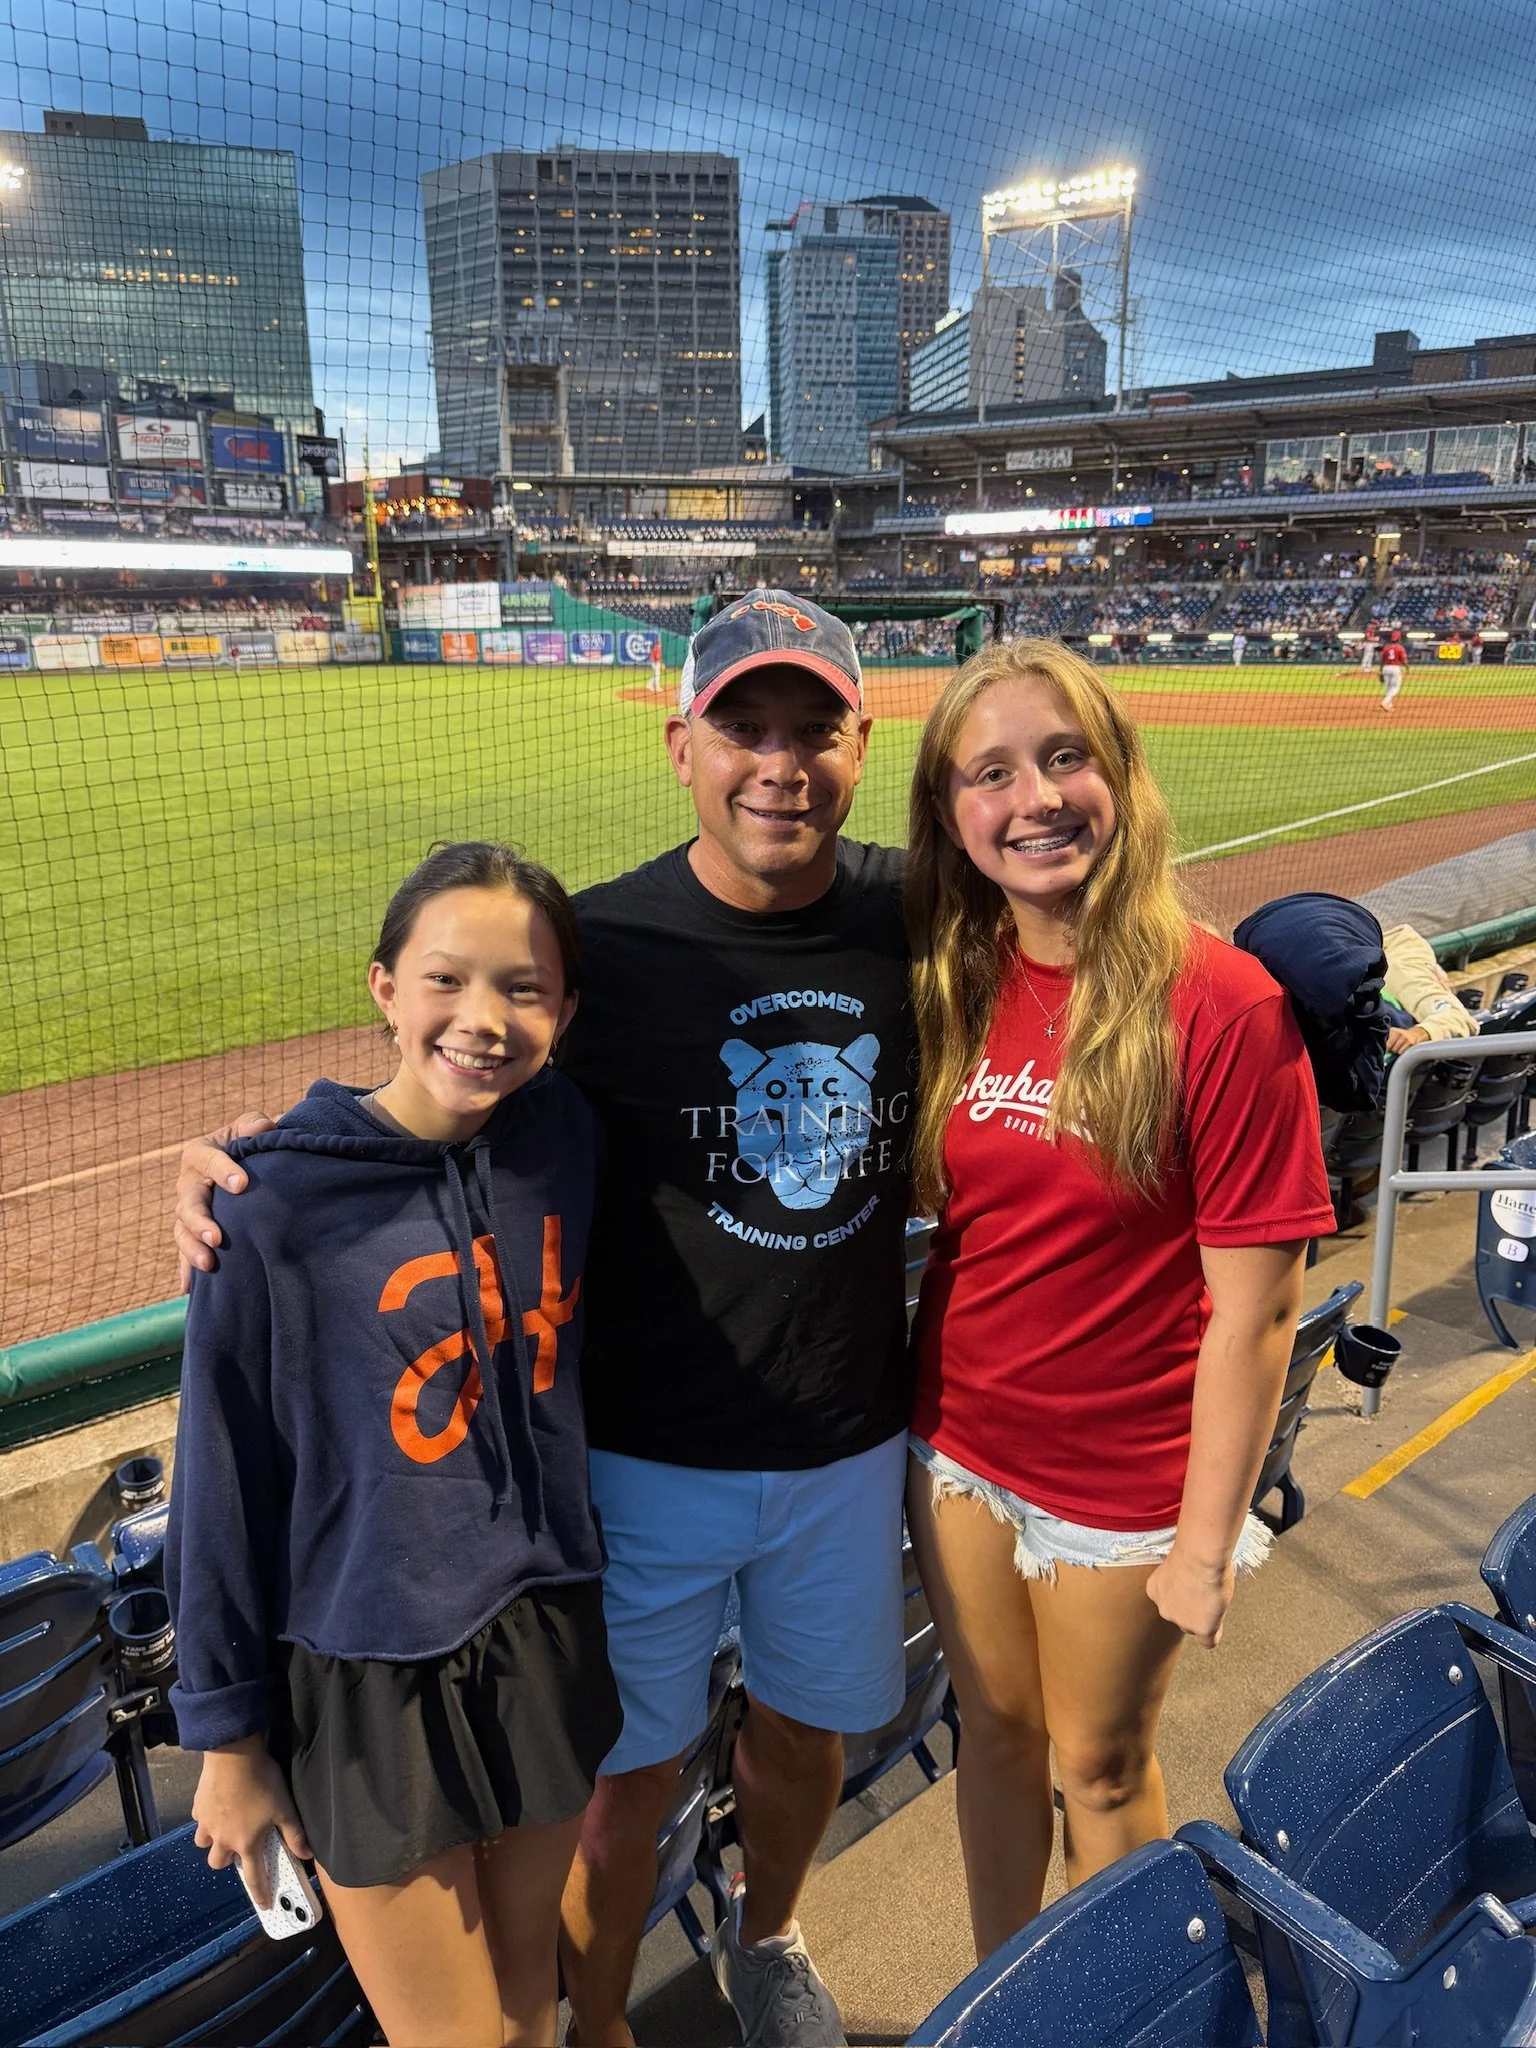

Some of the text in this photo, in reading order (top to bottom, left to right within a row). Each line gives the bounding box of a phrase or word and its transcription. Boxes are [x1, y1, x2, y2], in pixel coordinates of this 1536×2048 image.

[130, 434, 190, 447] SIGN PRO
[729, 990, 866, 1026] OVERCOMER
[680, 1091, 909, 1140] TRAINING
[705, 1139, 893, 1184] FOR LIFE
[706, 1194, 881, 1251] TRAINING CENTER
[1507, 1243, 1518, 1257] B
